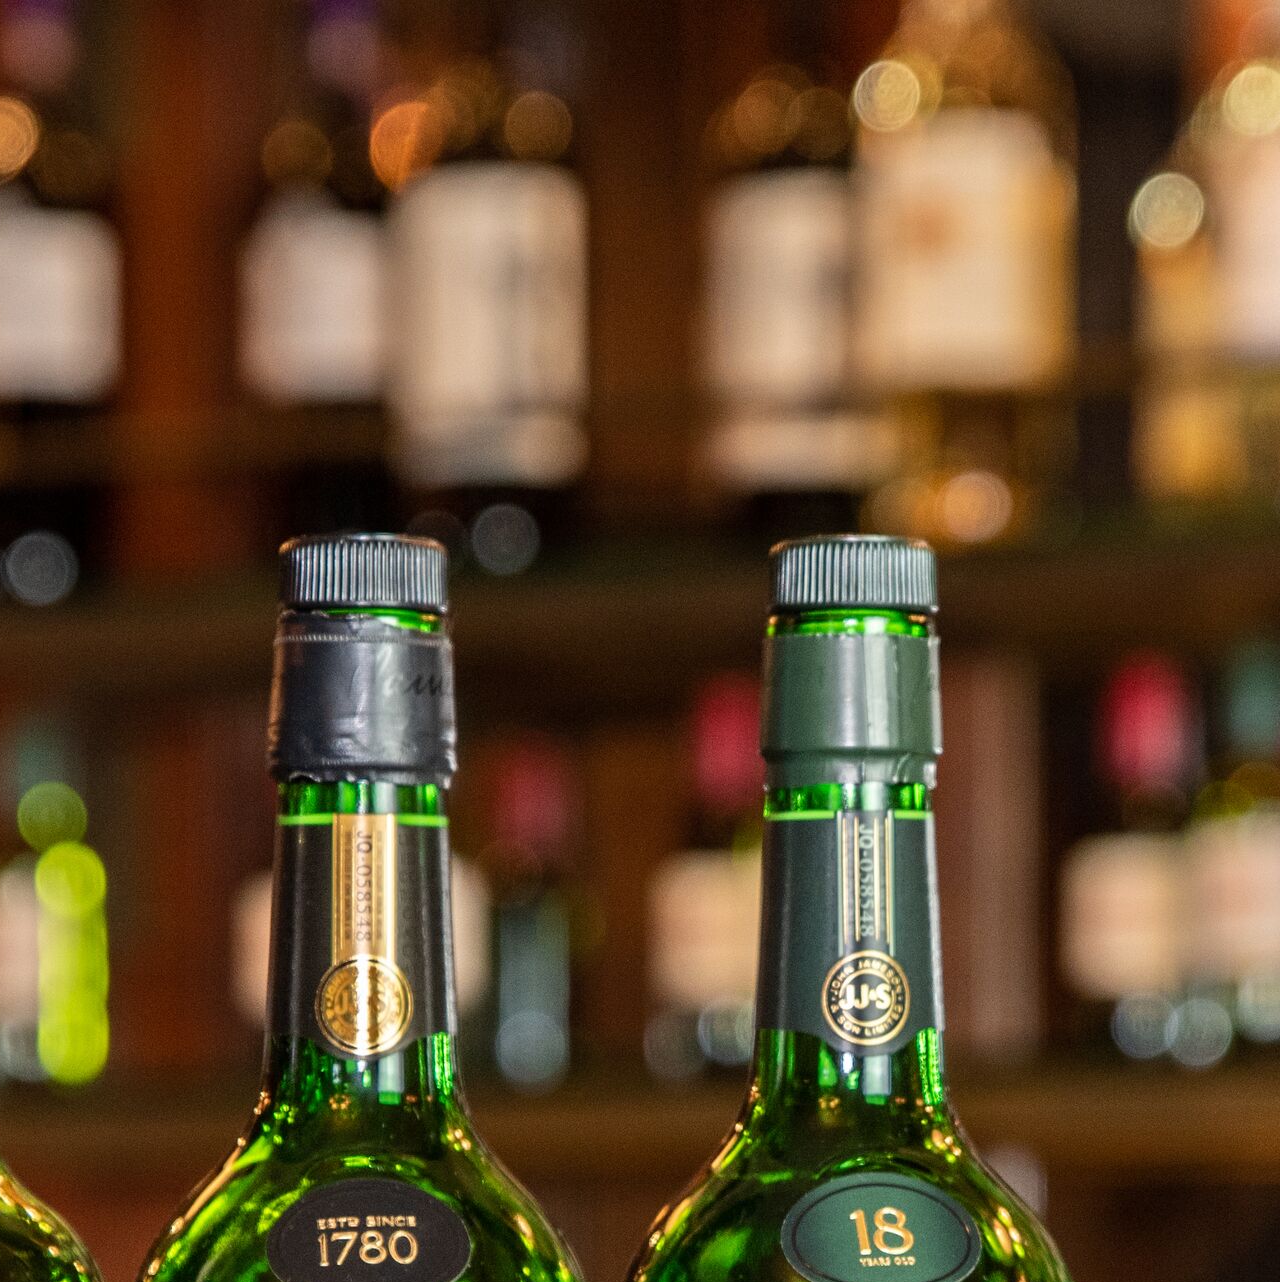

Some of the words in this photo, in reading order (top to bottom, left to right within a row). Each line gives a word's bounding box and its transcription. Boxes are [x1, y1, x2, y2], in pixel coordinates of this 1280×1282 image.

[317, 1217, 359, 1230] ESTD
[366, 1215, 417, 1228] SINCE
[849, 1206, 915, 1255] 18
[317, 1230, 419, 1267] 1780
[859, 1256, 891, 1267] YEARS
[894, 1256, 916, 1266] OLD
